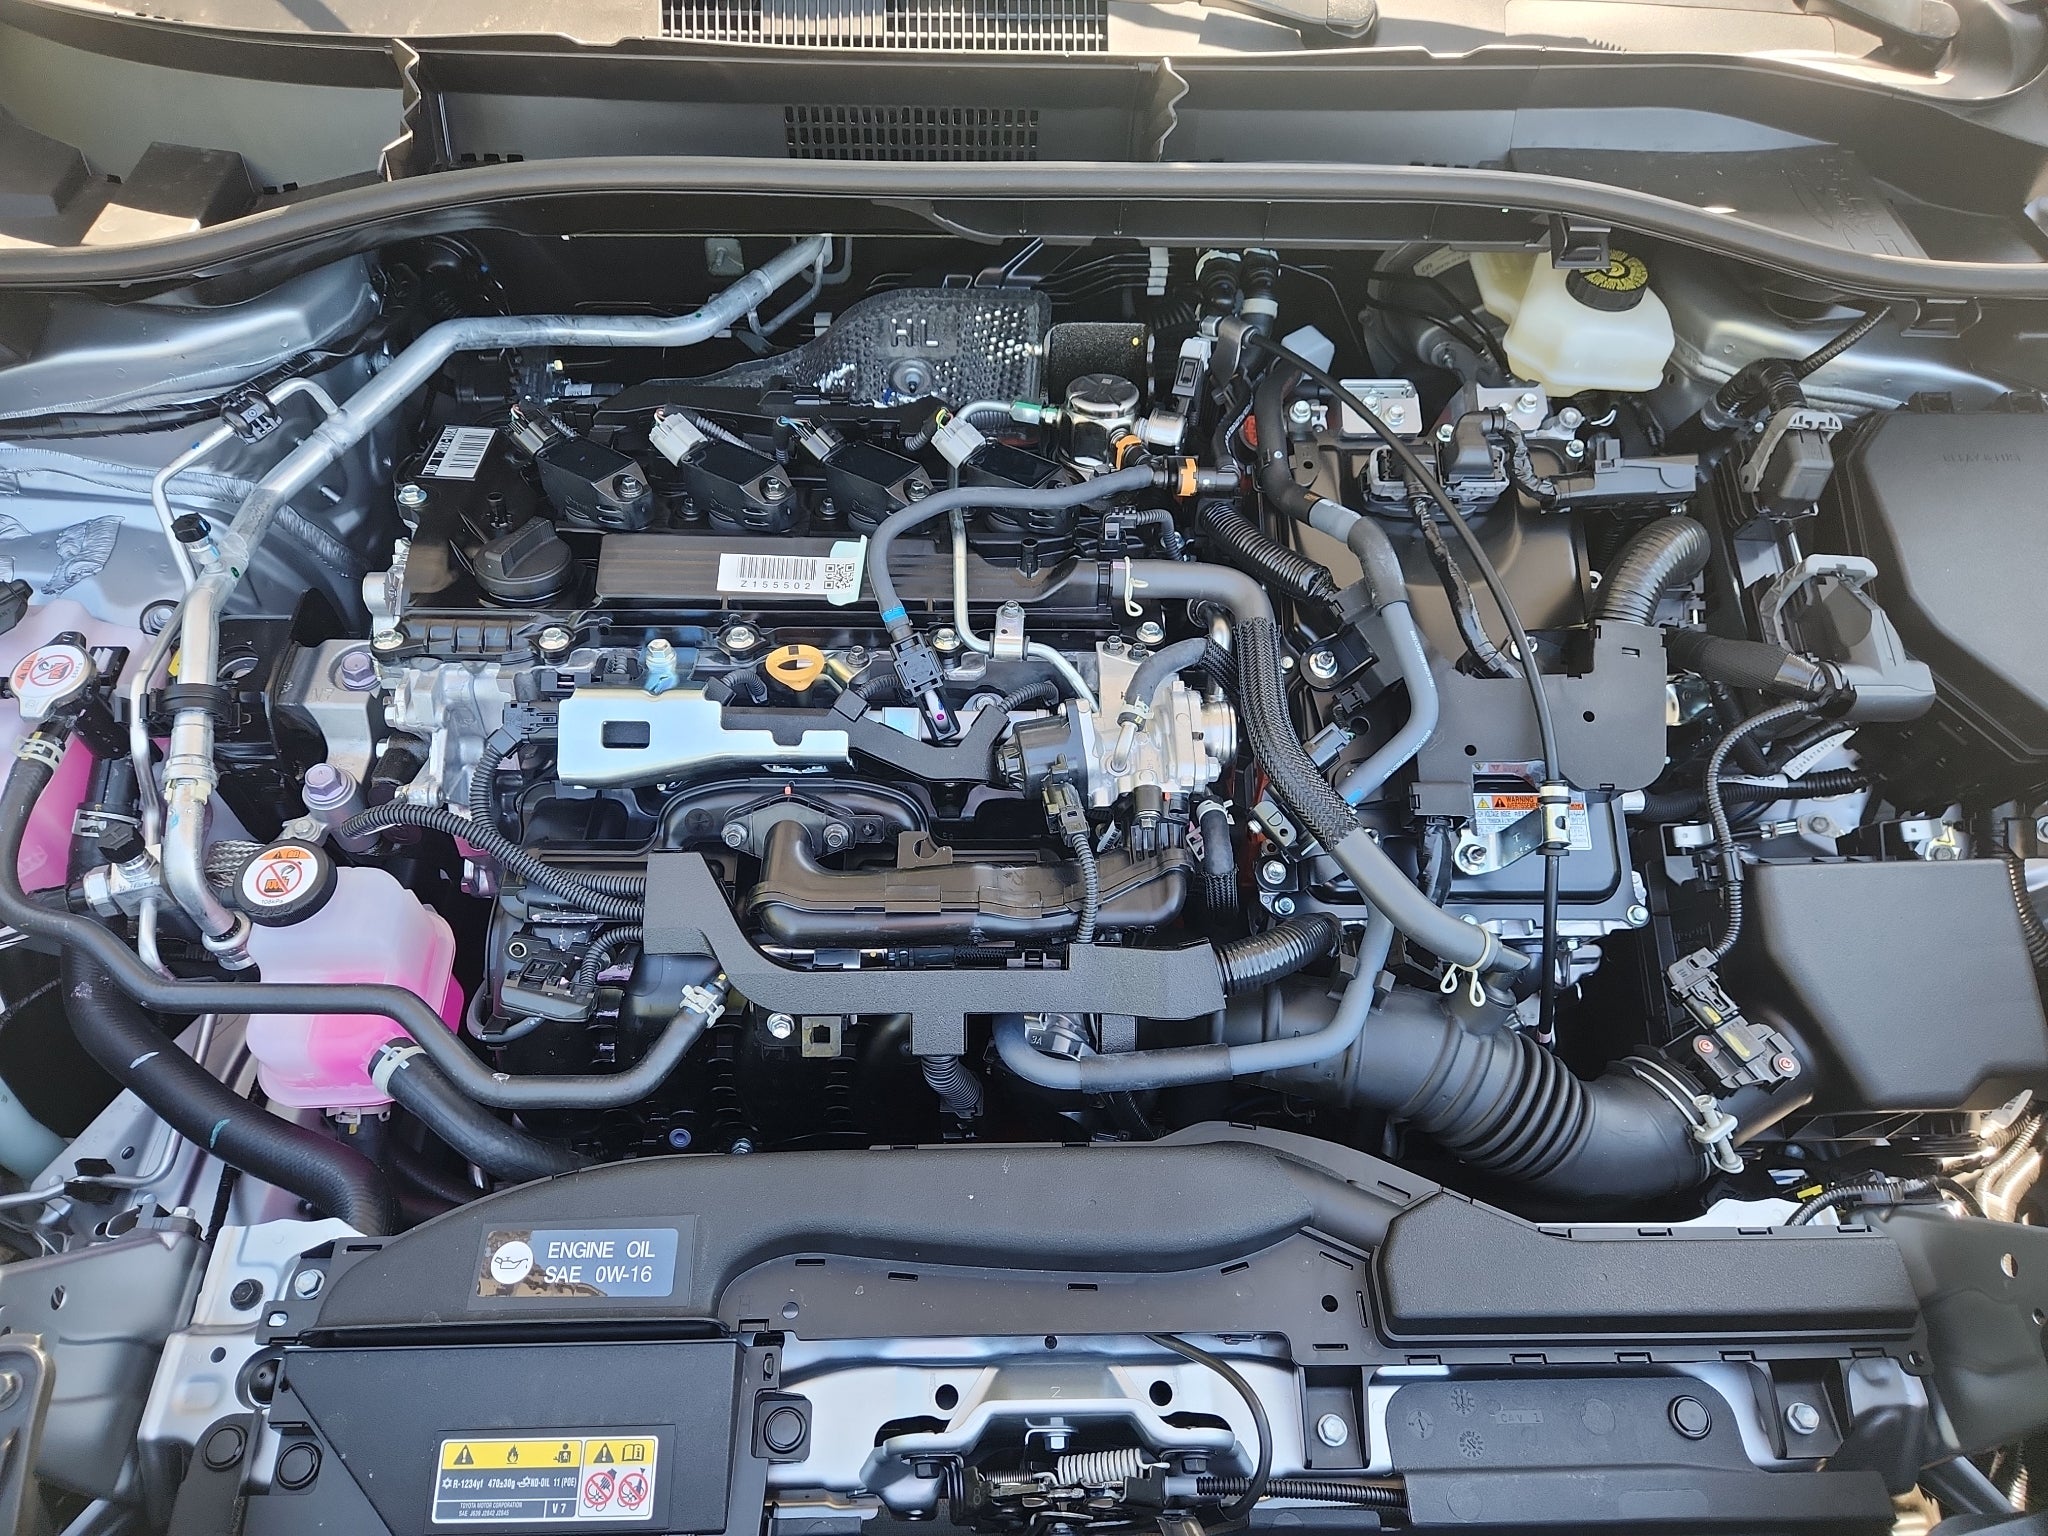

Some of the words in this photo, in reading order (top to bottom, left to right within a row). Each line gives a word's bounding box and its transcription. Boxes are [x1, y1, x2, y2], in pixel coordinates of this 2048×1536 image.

[740, 580, 811, 590] Z155502
[1506, 795, 1534, 803] WARNING
[547, 1241, 615, 1259] ENGINE
[626, 1240, 656, 1258] OIL
[543, 1266, 582, 1284] SAE
[595, 1265, 652, 1283] 0W-16
[452, 1478, 483, 1490] R-1234yf
[487, 1478, 516, 1490] 470±30g
[530, 1477, 550, 1488] ND-OIL
[553, 1477, 560, 1487] 11
[561, 1476, 577, 1488] (POE)
[492, 1501, 523, 1509] CORPORATION
[552, 1503, 559, 1514] V
[560, 1502, 567, 1513] 7
